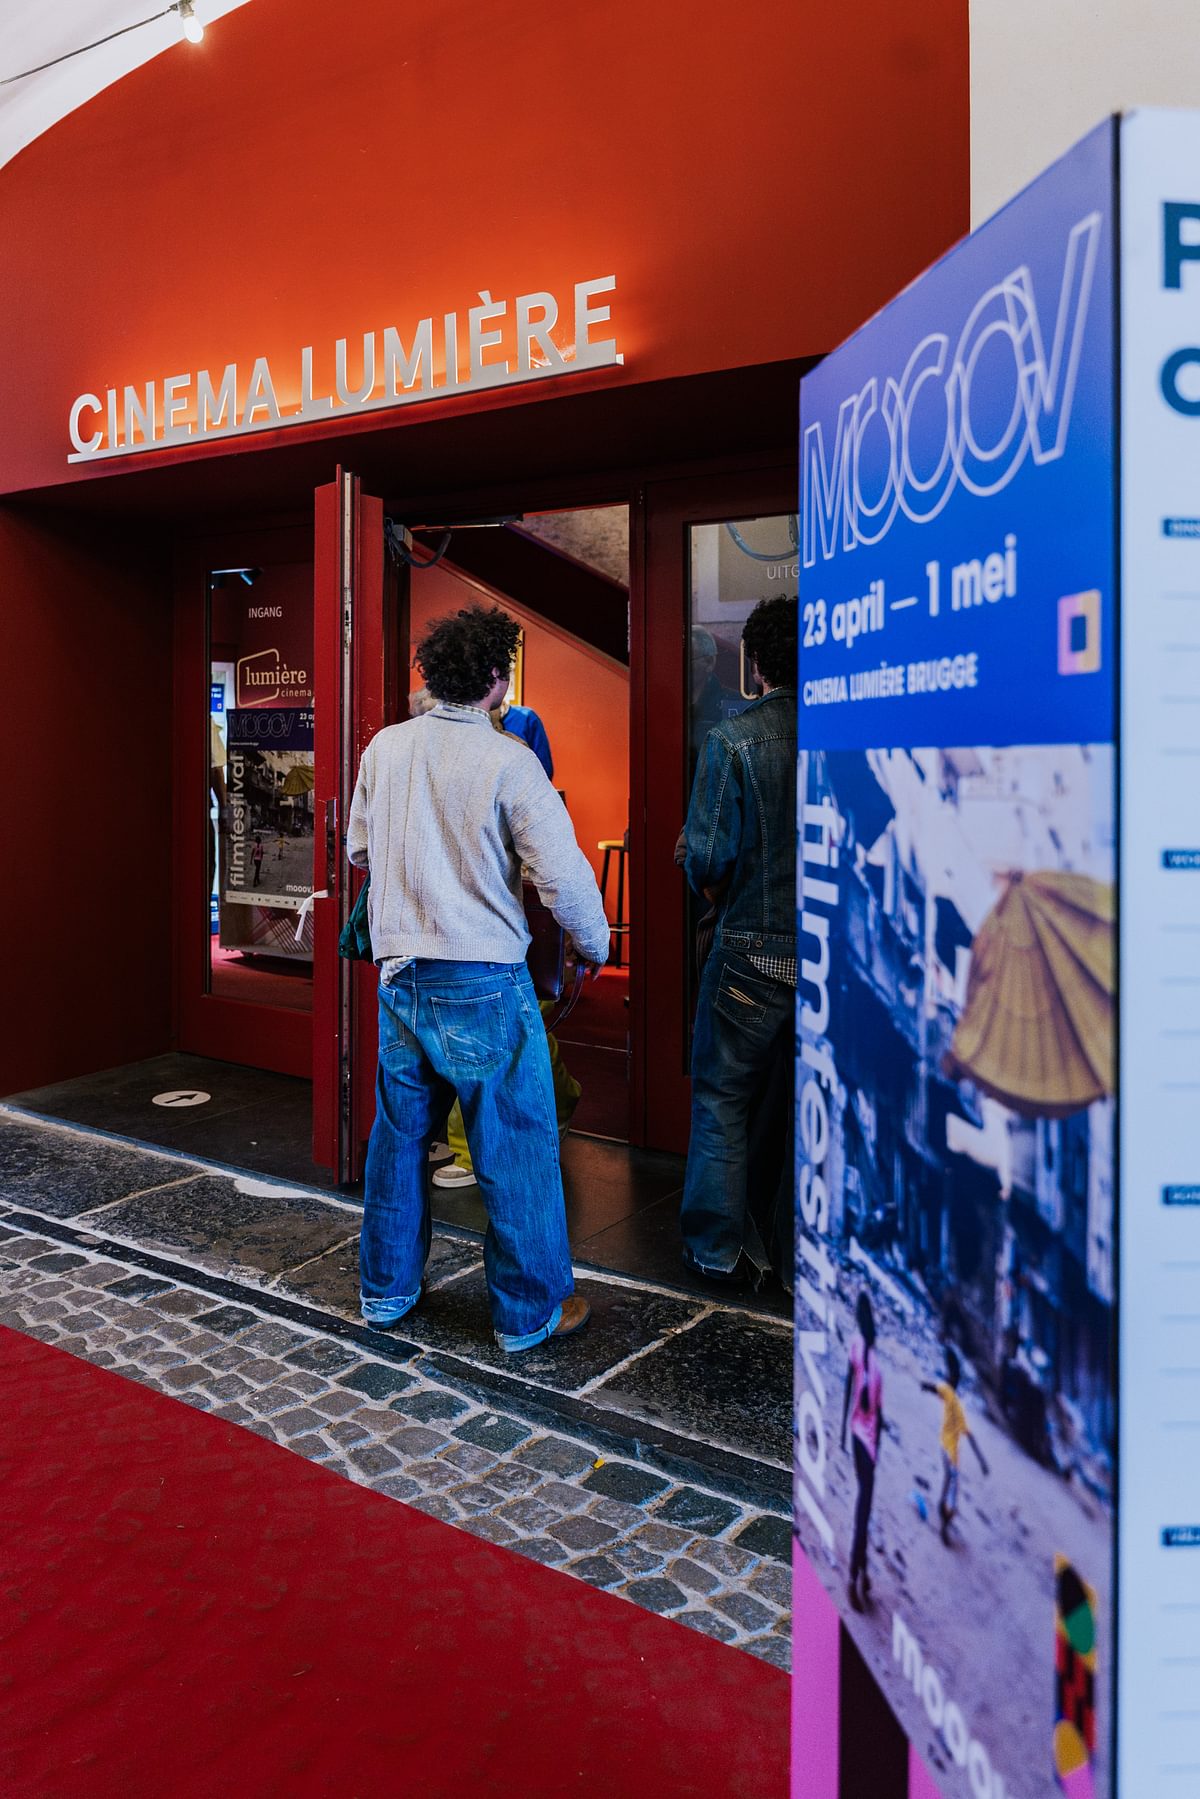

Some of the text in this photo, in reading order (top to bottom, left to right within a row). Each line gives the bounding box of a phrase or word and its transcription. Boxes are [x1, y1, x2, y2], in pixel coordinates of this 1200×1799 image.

[69, 275, 618, 455] CINEMA LUMIÈRE
[802, 211, 1102, 568] MOOOV
[248, 606, 283, 619] INGANG
[803, 599, 827, 648] 23
[832, 579, 885, 648] april
[926, 560, 939, 616] 1
[951, 533, 1017, 611] mei
[245, 664, 307, 686] lumière
[281, 688, 312, 698] cinema
[803, 652, 978, 706] CINEMA LUMIÈRE BRUGGE
[230, 751, 245, 886] filmfestival
[286, 884, 314, 894] mooov.
[799, 796, 841, 1550] filmfestival
